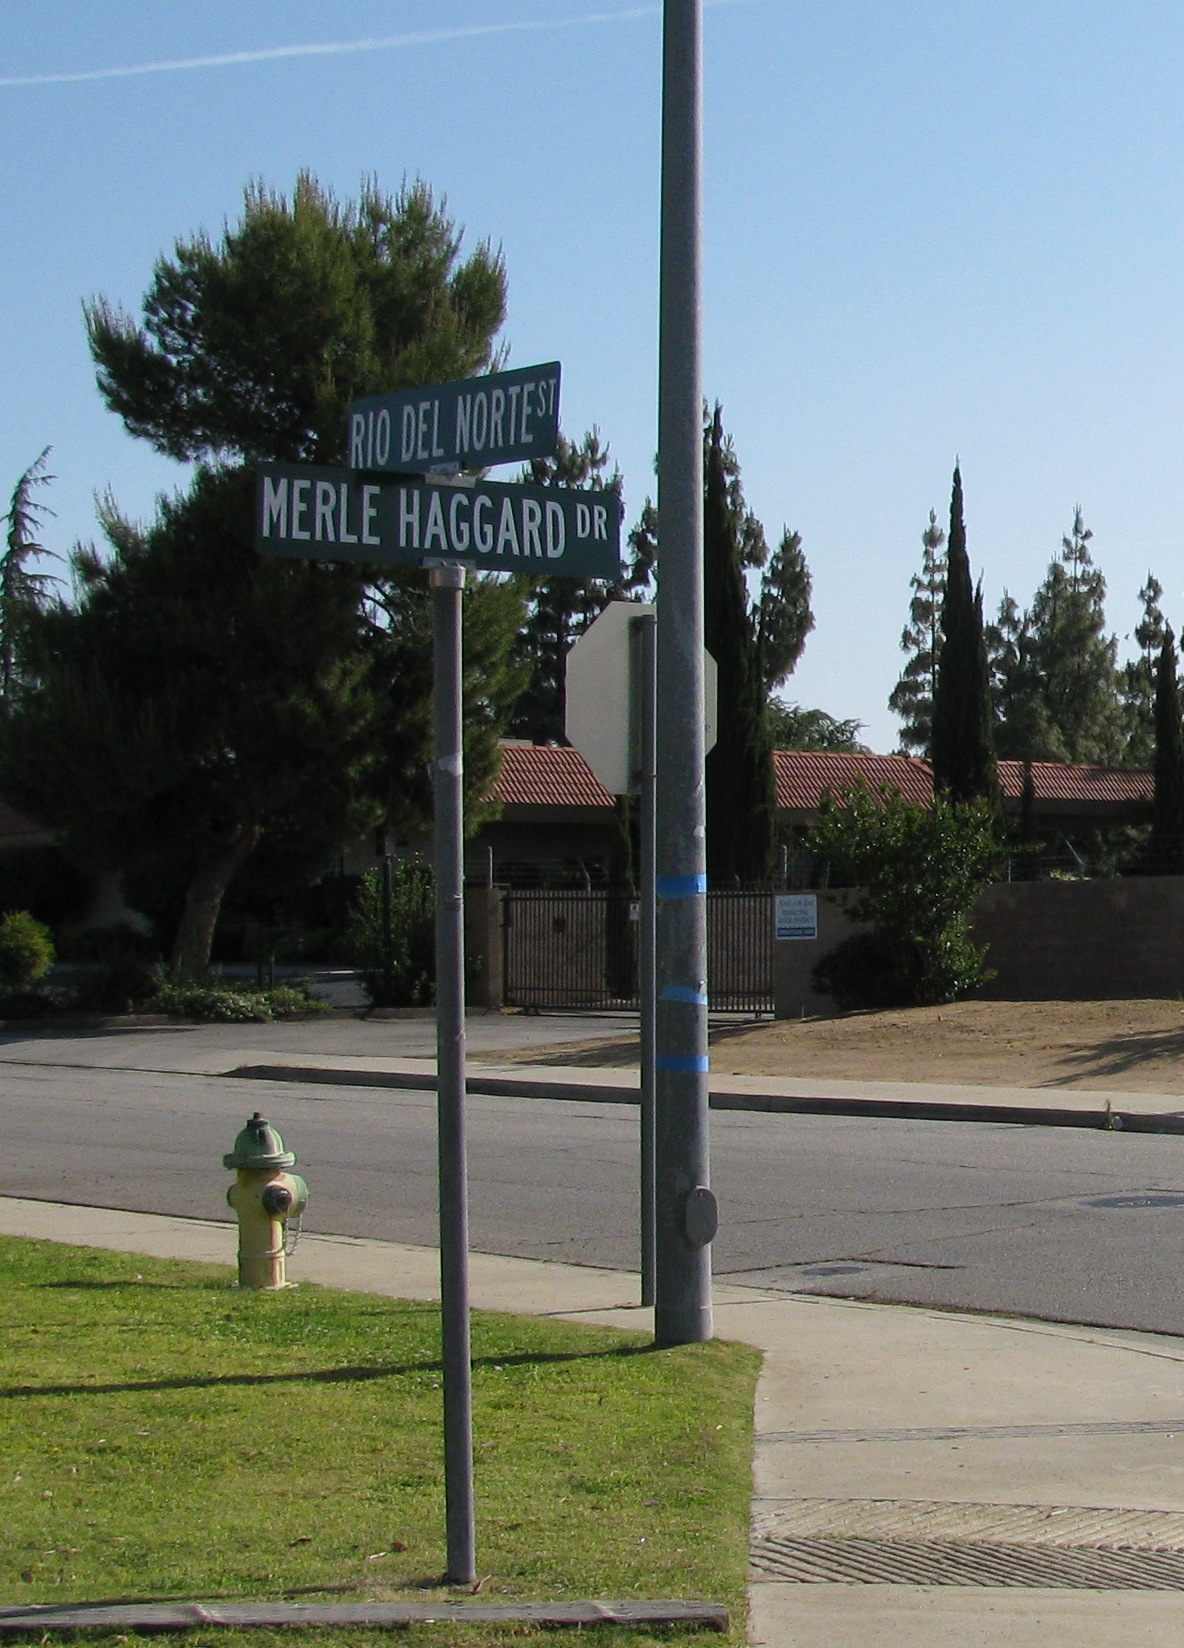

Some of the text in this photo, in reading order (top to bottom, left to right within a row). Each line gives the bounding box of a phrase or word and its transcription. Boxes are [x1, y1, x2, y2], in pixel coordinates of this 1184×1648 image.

[351, 378, 557, 469] RIO DEL NORTE ST
[262, 476, 608, 559] MERLE HAGGARD DR
